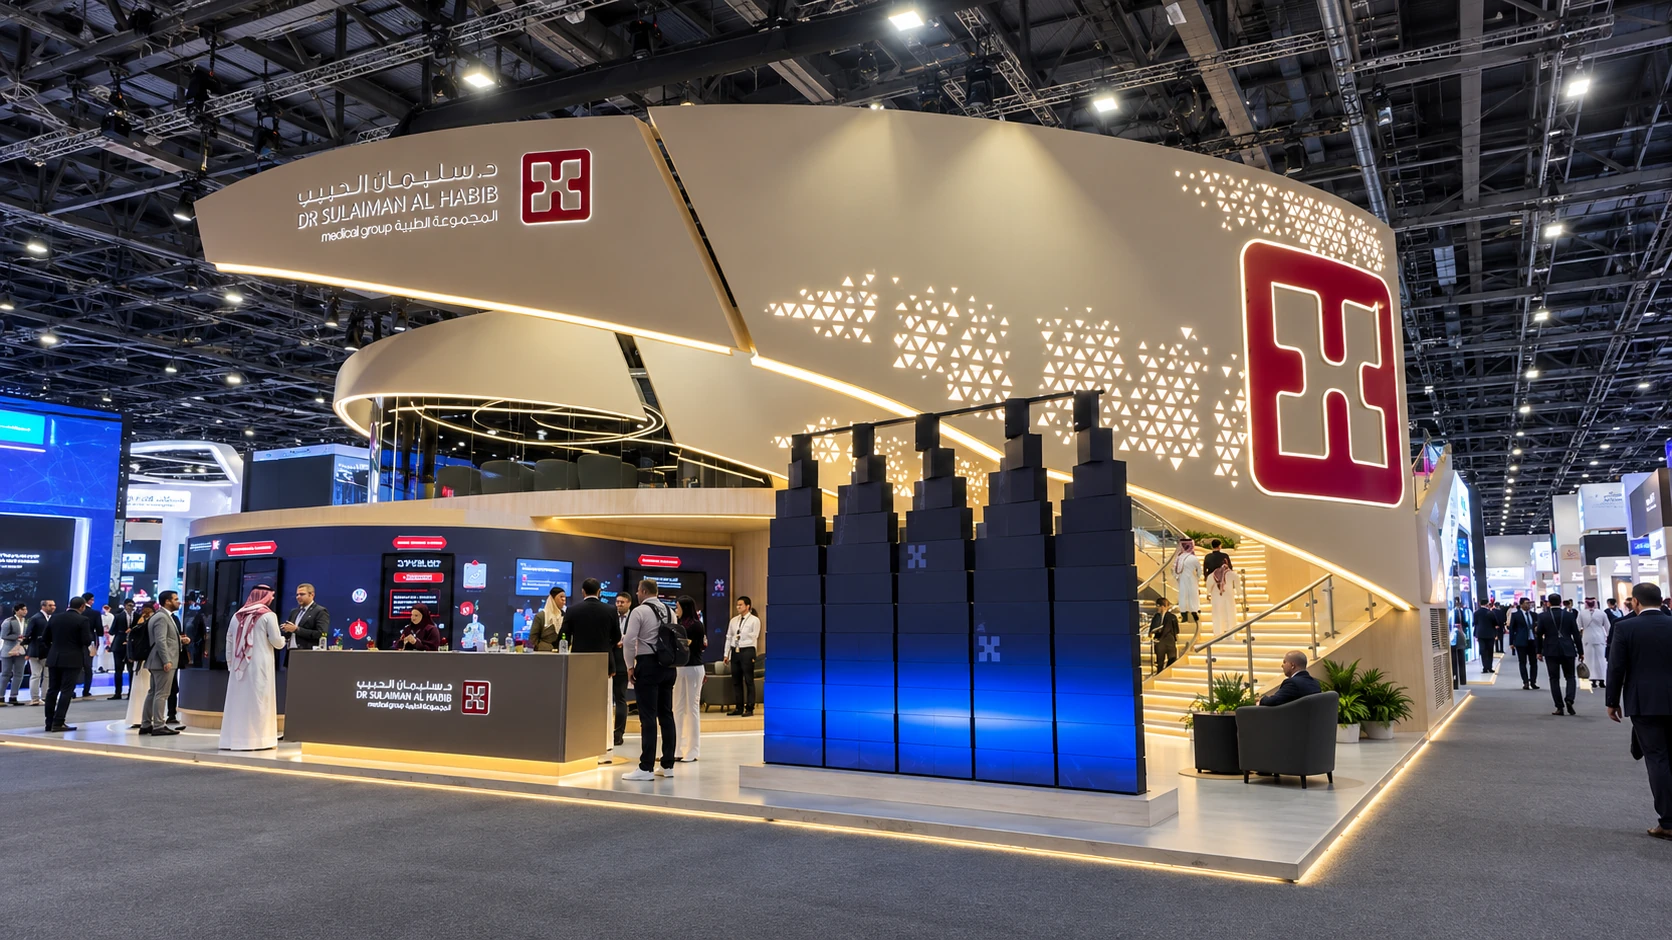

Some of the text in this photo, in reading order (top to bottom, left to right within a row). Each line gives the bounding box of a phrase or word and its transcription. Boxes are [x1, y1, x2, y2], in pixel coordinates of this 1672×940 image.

[297, 174, 368, 207] الحبيب
[297, 185, 498, 229] DR SULAIMAN AL HABIB
[321, 223, 392, 242] medical group
[395, 210, 498, 233] المجموعة الطبية
[356, 690, 368, 699] DR
[369, 690, 412, 700] SULAIMAN
[413, 692, 424, 701] AL
